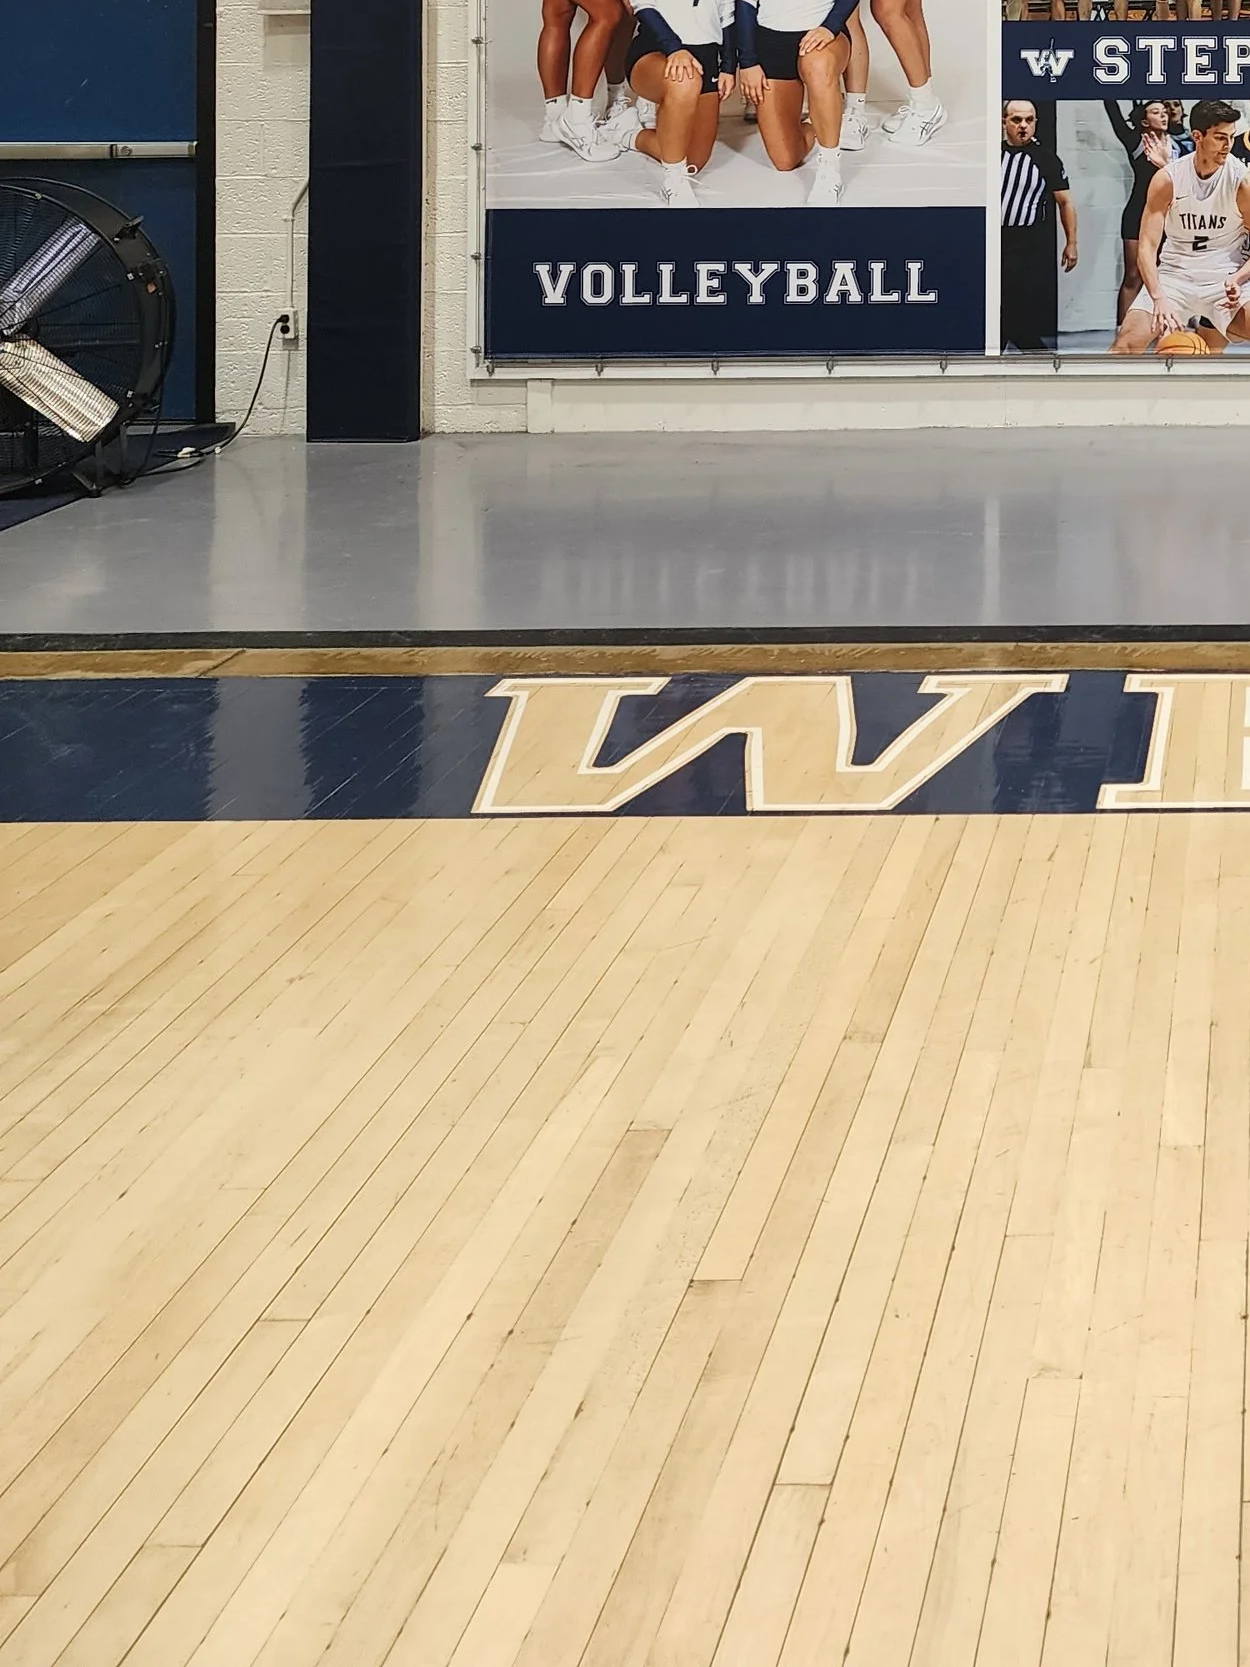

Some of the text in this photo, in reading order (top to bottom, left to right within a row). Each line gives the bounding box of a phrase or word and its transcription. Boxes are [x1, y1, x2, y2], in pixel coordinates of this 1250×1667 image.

[1020, 48, 1074, 77] W
[1179, 212, 1227, 230] TITANS
[1192, 235, 1209, 251] 2
[533, 260, 939, 307] VOLLEYBALL
